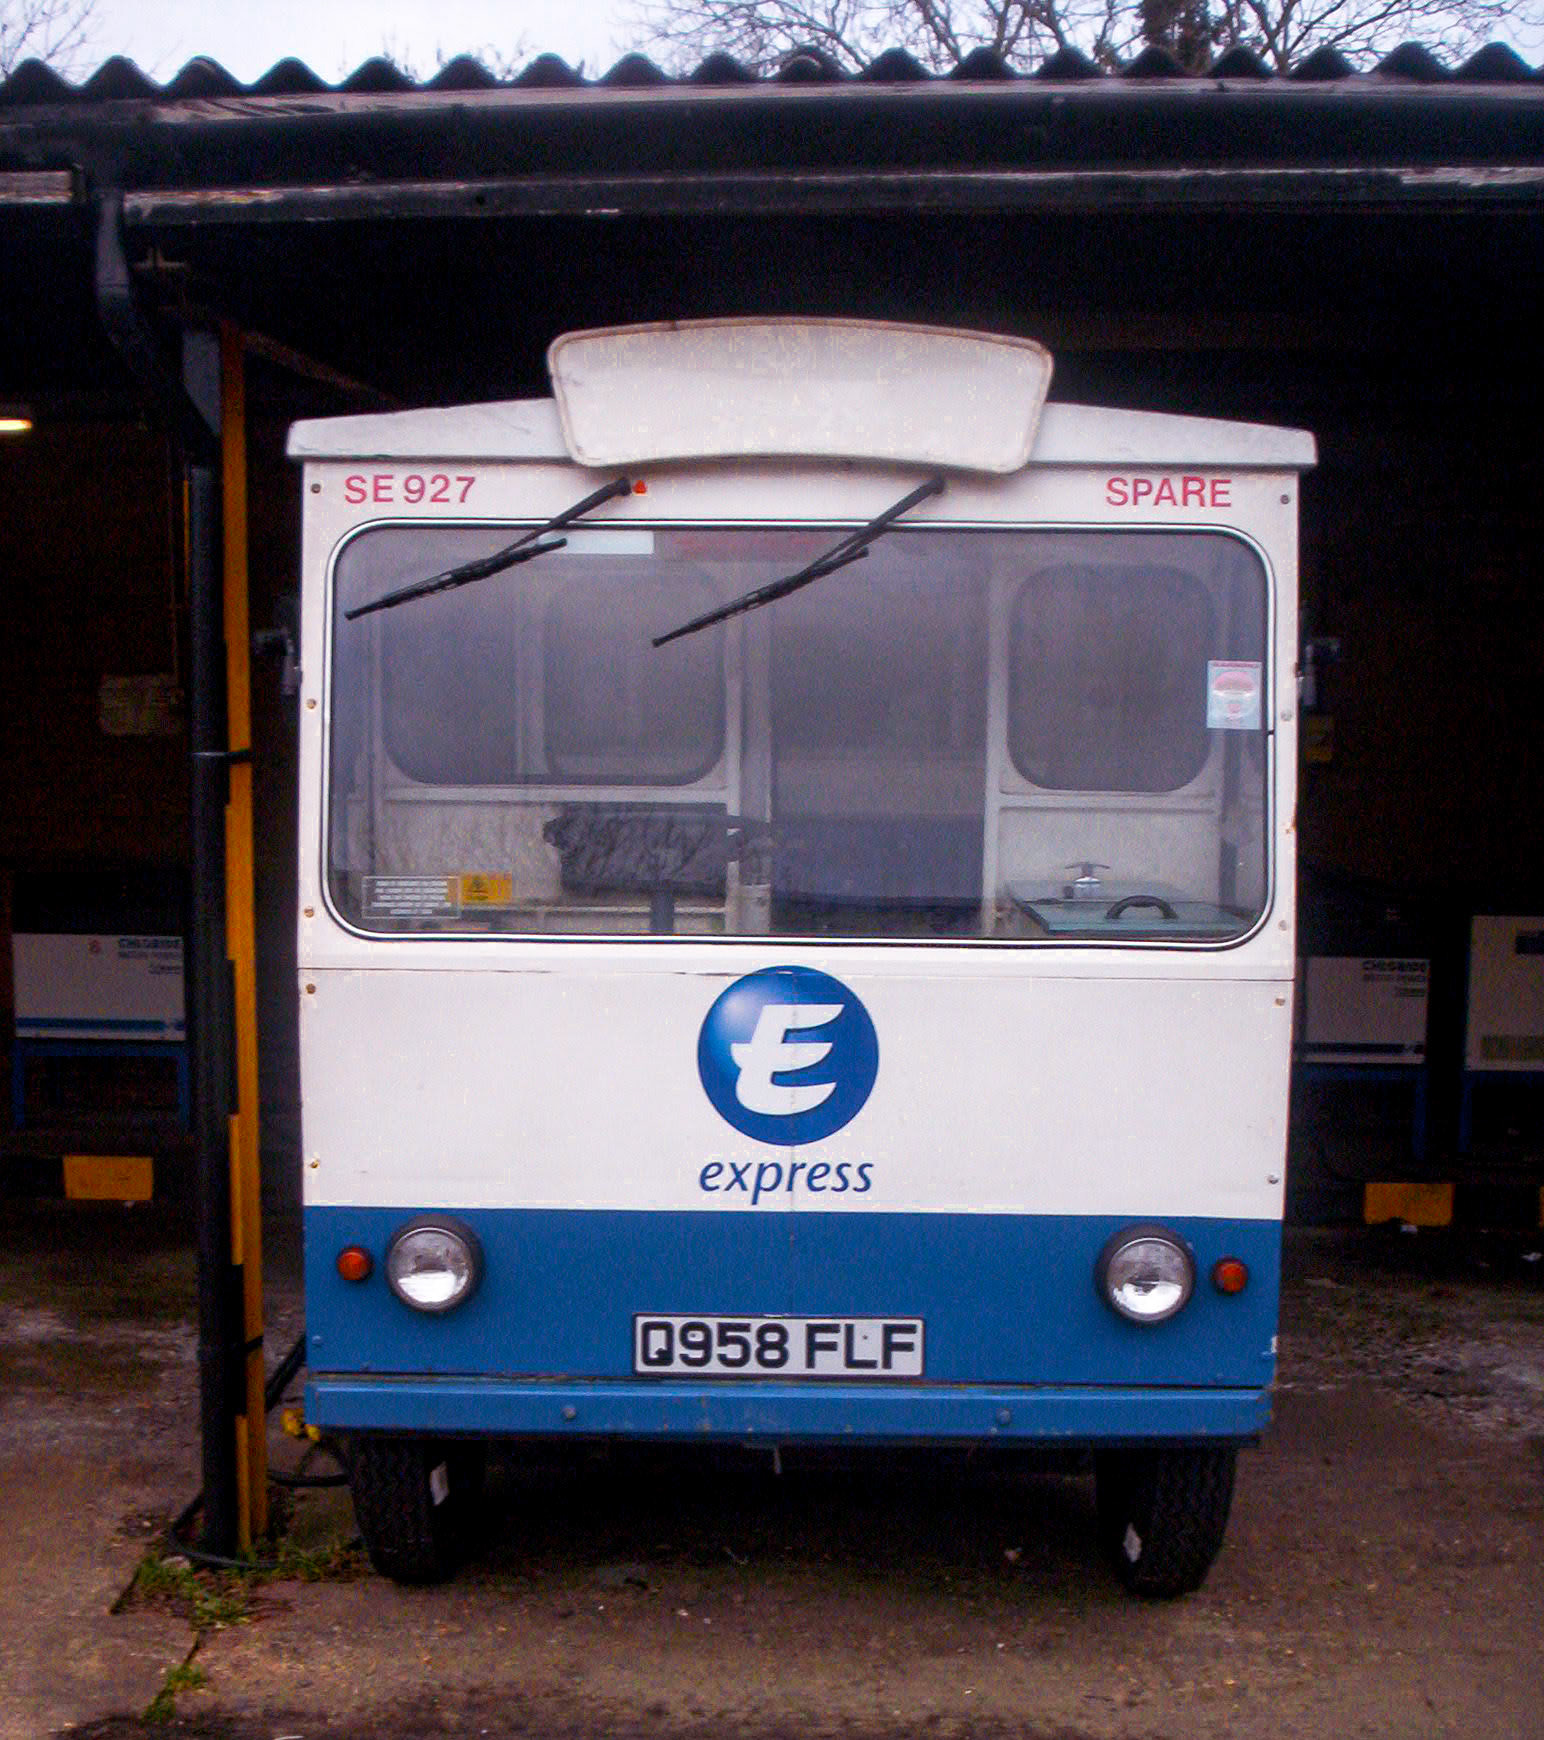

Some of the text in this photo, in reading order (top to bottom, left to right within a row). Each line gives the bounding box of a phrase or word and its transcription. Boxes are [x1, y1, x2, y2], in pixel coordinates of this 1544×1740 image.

[1106, 476, 1232, 507] SPARE
[699, 1161, 874, 1205] express
[641, 1321, 917, 1370] Q958 FLF
